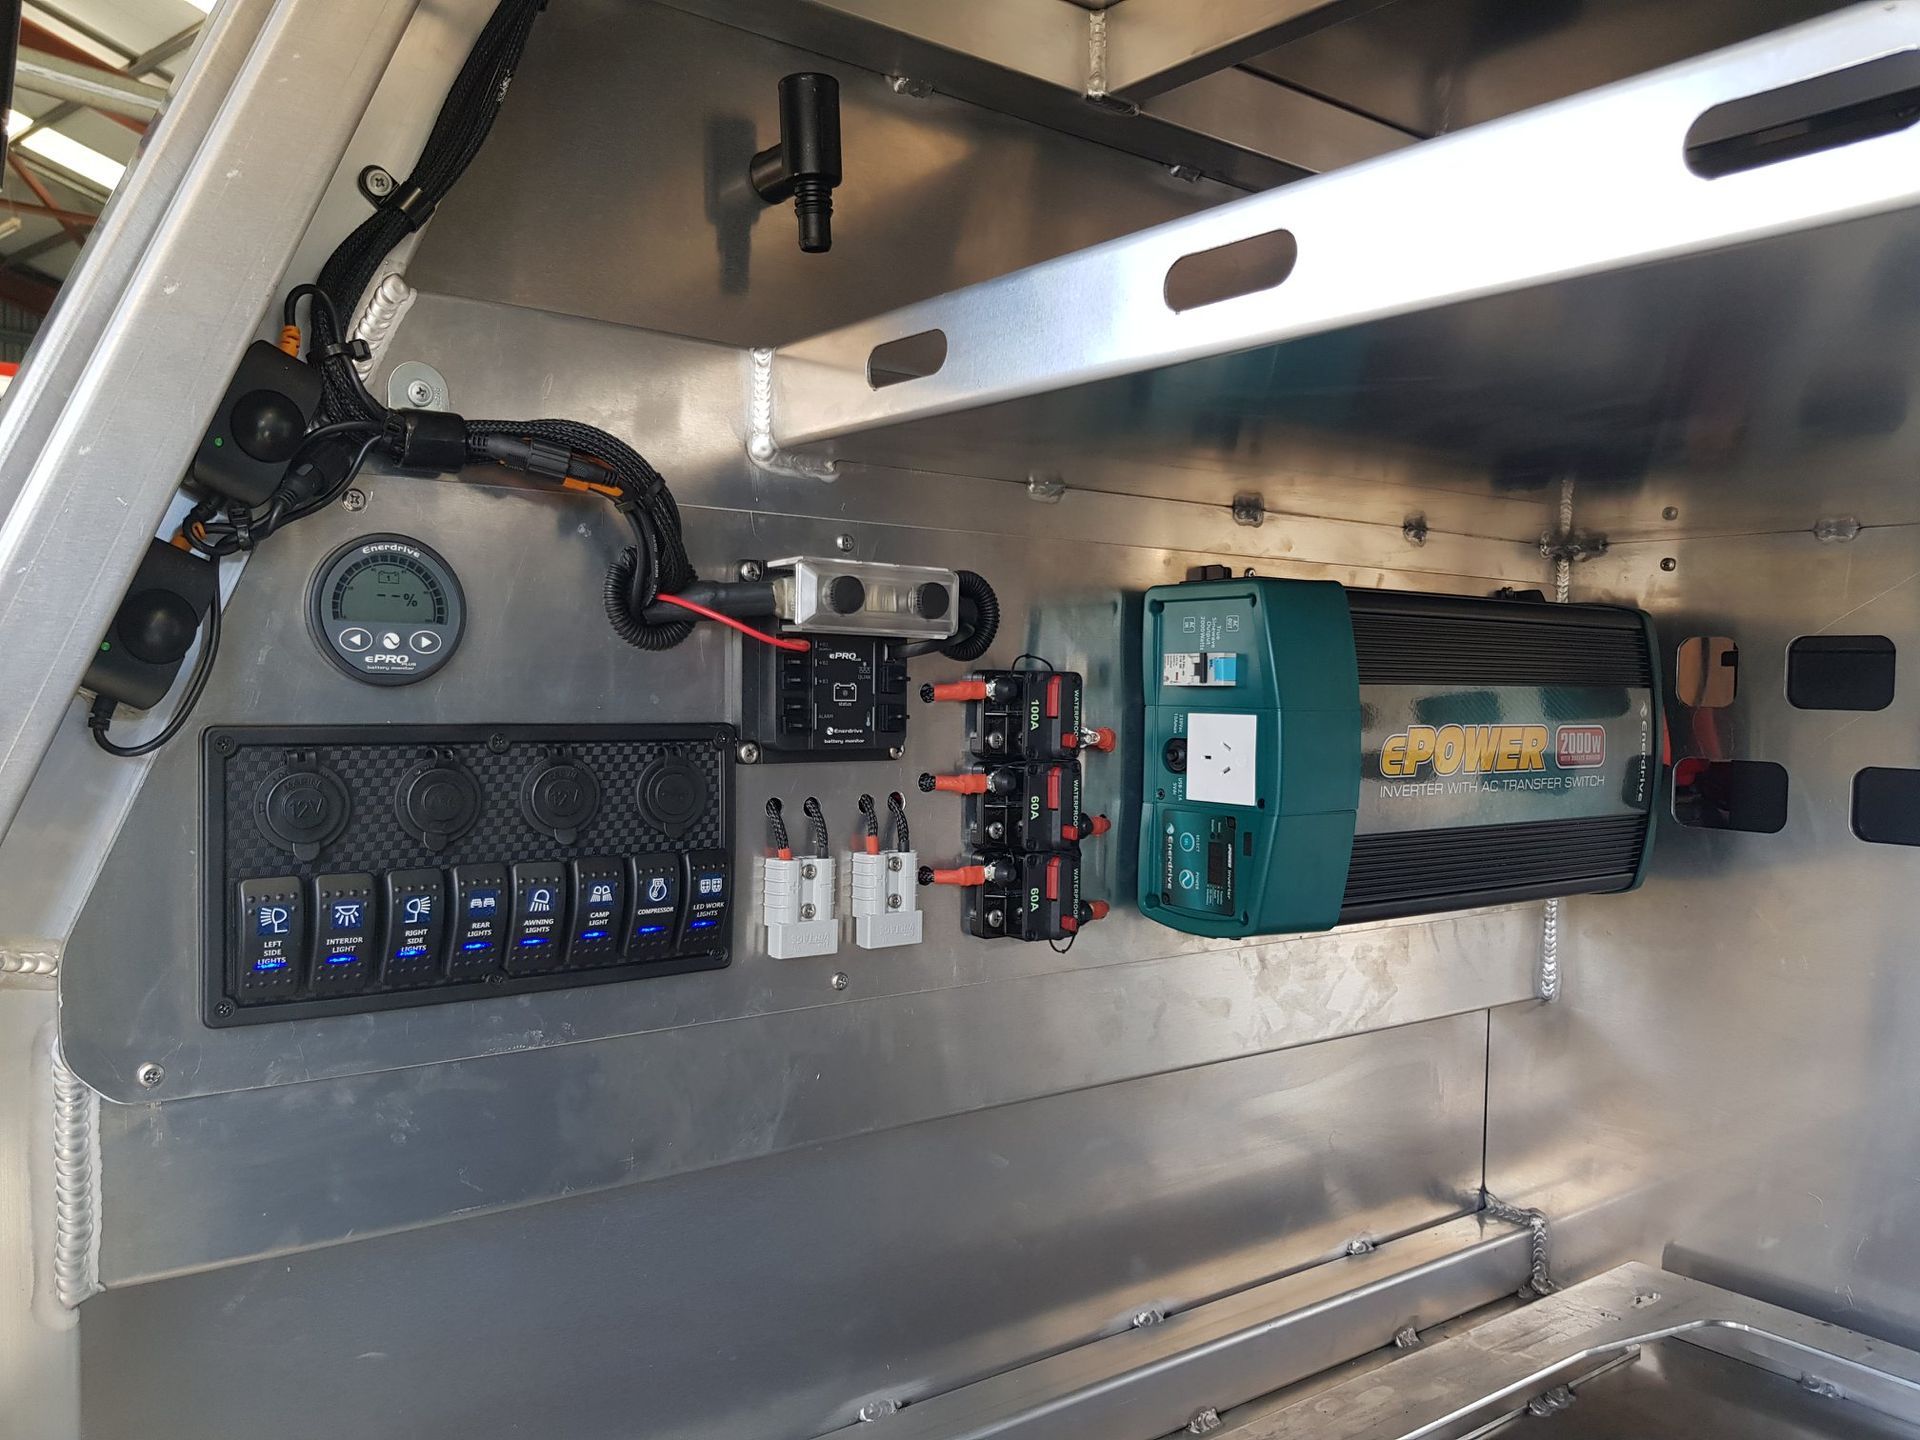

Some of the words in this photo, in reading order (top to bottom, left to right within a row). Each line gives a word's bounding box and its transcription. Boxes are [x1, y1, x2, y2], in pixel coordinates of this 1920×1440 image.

[362, 544, 420, 558] Enerdrive
[365, 654, 409, 663] ePRO
[829, 652, 856, 660] ePRO
[1030, 699, 1039, 731] 100A
[1380, 724, 1549, 777] ePOWER
[1637, 720, 1647, 802] Enerdrive
[1380, 785, 1443, 798] INVERTER
[1447, 783, 1478, 794] WITH
[1481, 782, 1499, 792] AC
[1503, 778, 1562, 791] TRANSFER
[1565, 775, 1605, 788] SWITCH
[1031, 796, 1039, 820] 60A
[1031, 887, 1039, 912] 60A
[637, 906, 674, 915] COMPRESSOR
[693, 903, 706, 911] LED
[707, 901, 725, 909] WORK
[590, 911, 609, 919] CAMP
[696, 910, 719, 918] LIGHTS
[472, 921, 490, 929] REAR
[523, 918, 554, 926] AWNING
[589, 918, 609, 926] LIGHT
[405, 929, 428, 937] RIGHT
[467, 929, 492, 937] LIGHTS
[525, 925, 550, 934] LIGHTS
[264, 940, 282, 949] LEFT
[326, 936, 363, 946] INTERIOR
[264, 948, 282, 957] SIDE
[332, 945, 355, 953] LIGHT
[401, 945, 427, 953] LIGHTS
[257, 957, 287, 966] LIGHTS
